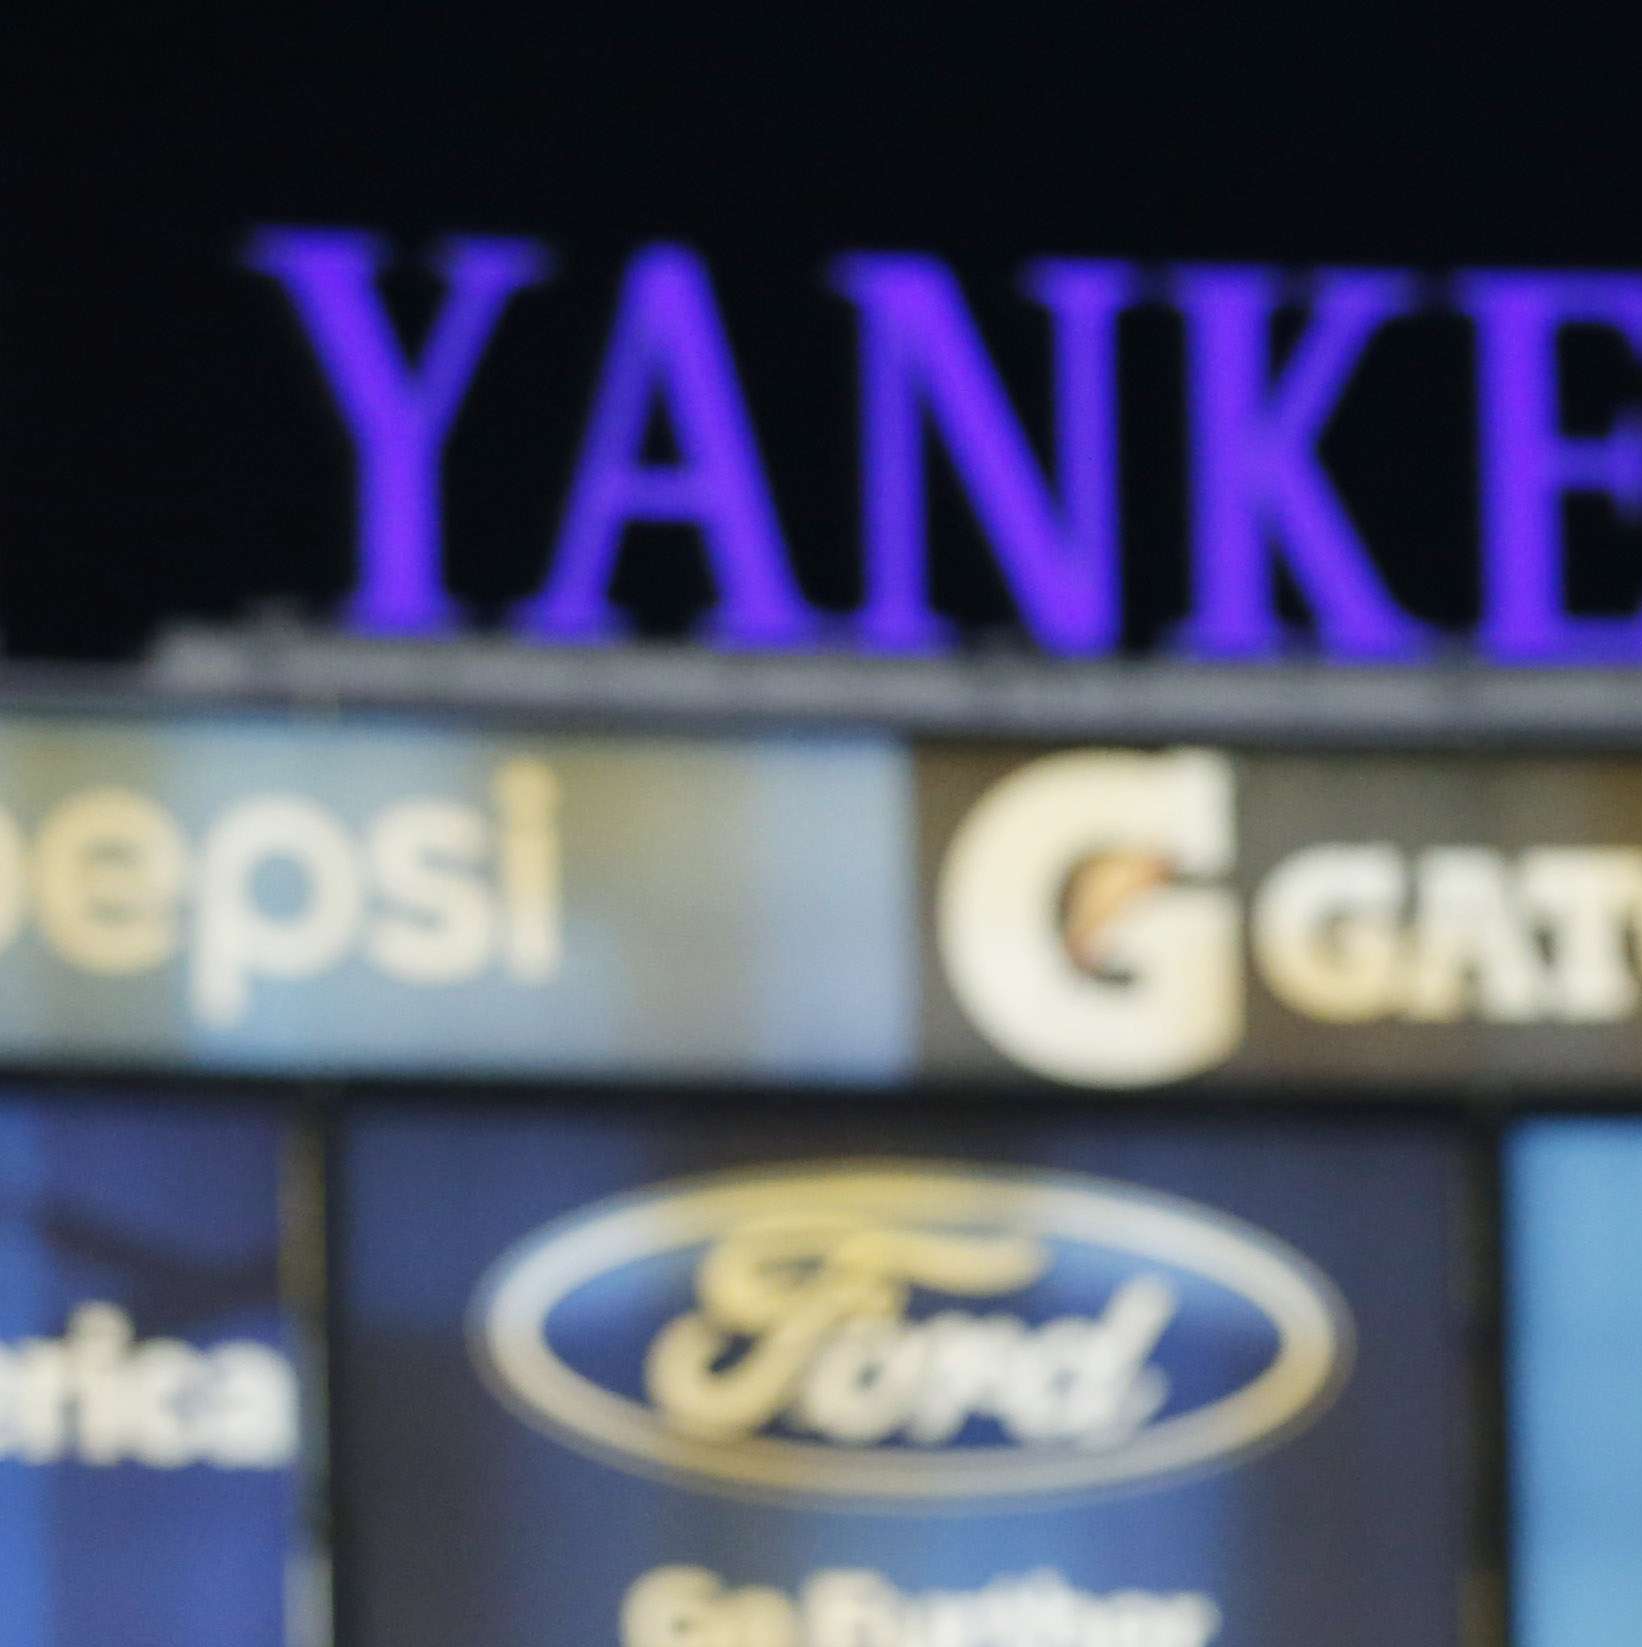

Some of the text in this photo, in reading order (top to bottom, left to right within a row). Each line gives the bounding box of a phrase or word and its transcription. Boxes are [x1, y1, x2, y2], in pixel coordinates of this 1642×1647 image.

[0, 758, 562, 1028] epsi
[938, 748, 1245, 1090] G
[0, 1298, 298, 1470] rica
[646, 1208, 1182, 1452] Ford
